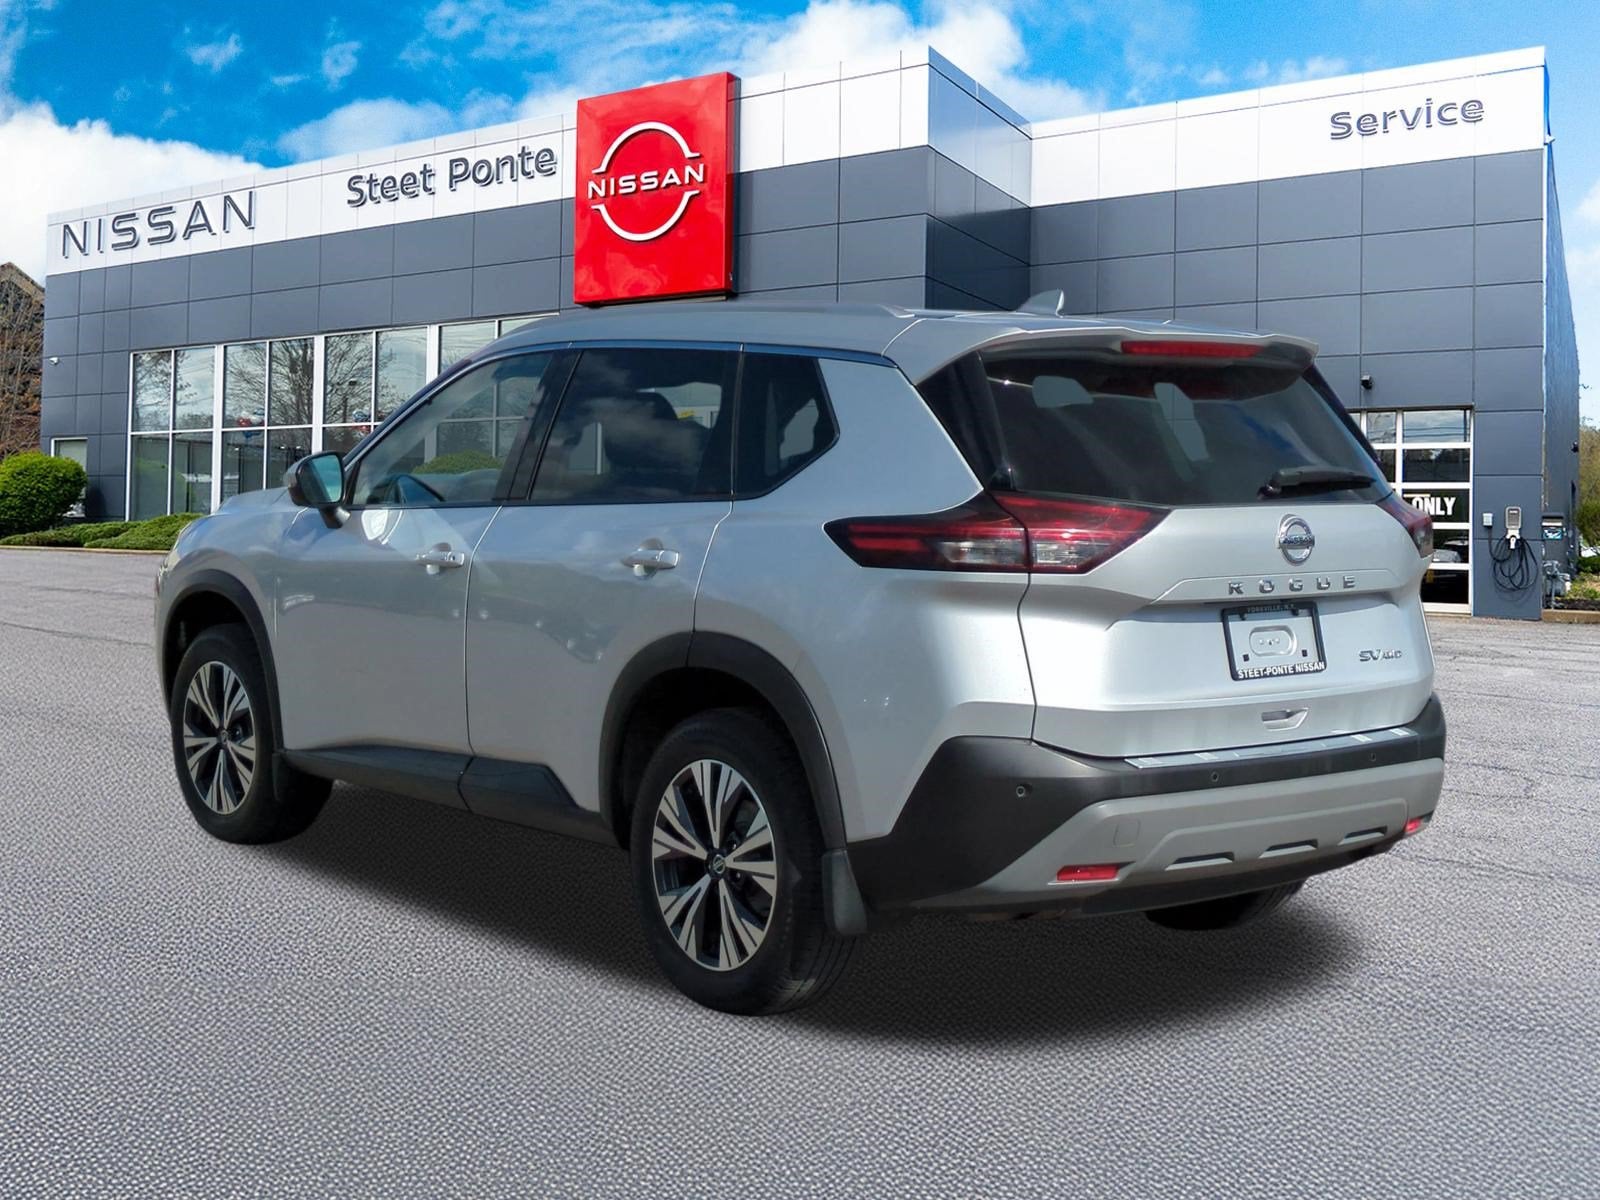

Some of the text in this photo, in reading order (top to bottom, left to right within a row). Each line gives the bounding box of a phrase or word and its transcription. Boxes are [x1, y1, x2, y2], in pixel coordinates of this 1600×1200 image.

[1330, 98, 1485, 140] Service
[347, 145, 557, 208] Steet Ponte
[587, 163, 705, 200] NISSAN
[62, 191, 255, 259] NISSAN
[1411, 496, 1457, 516] ONLY
[1228, 575, 1356, 595] ROGUE
[1237, 661, 1325, 679] STEET-PONTE NISSAN
